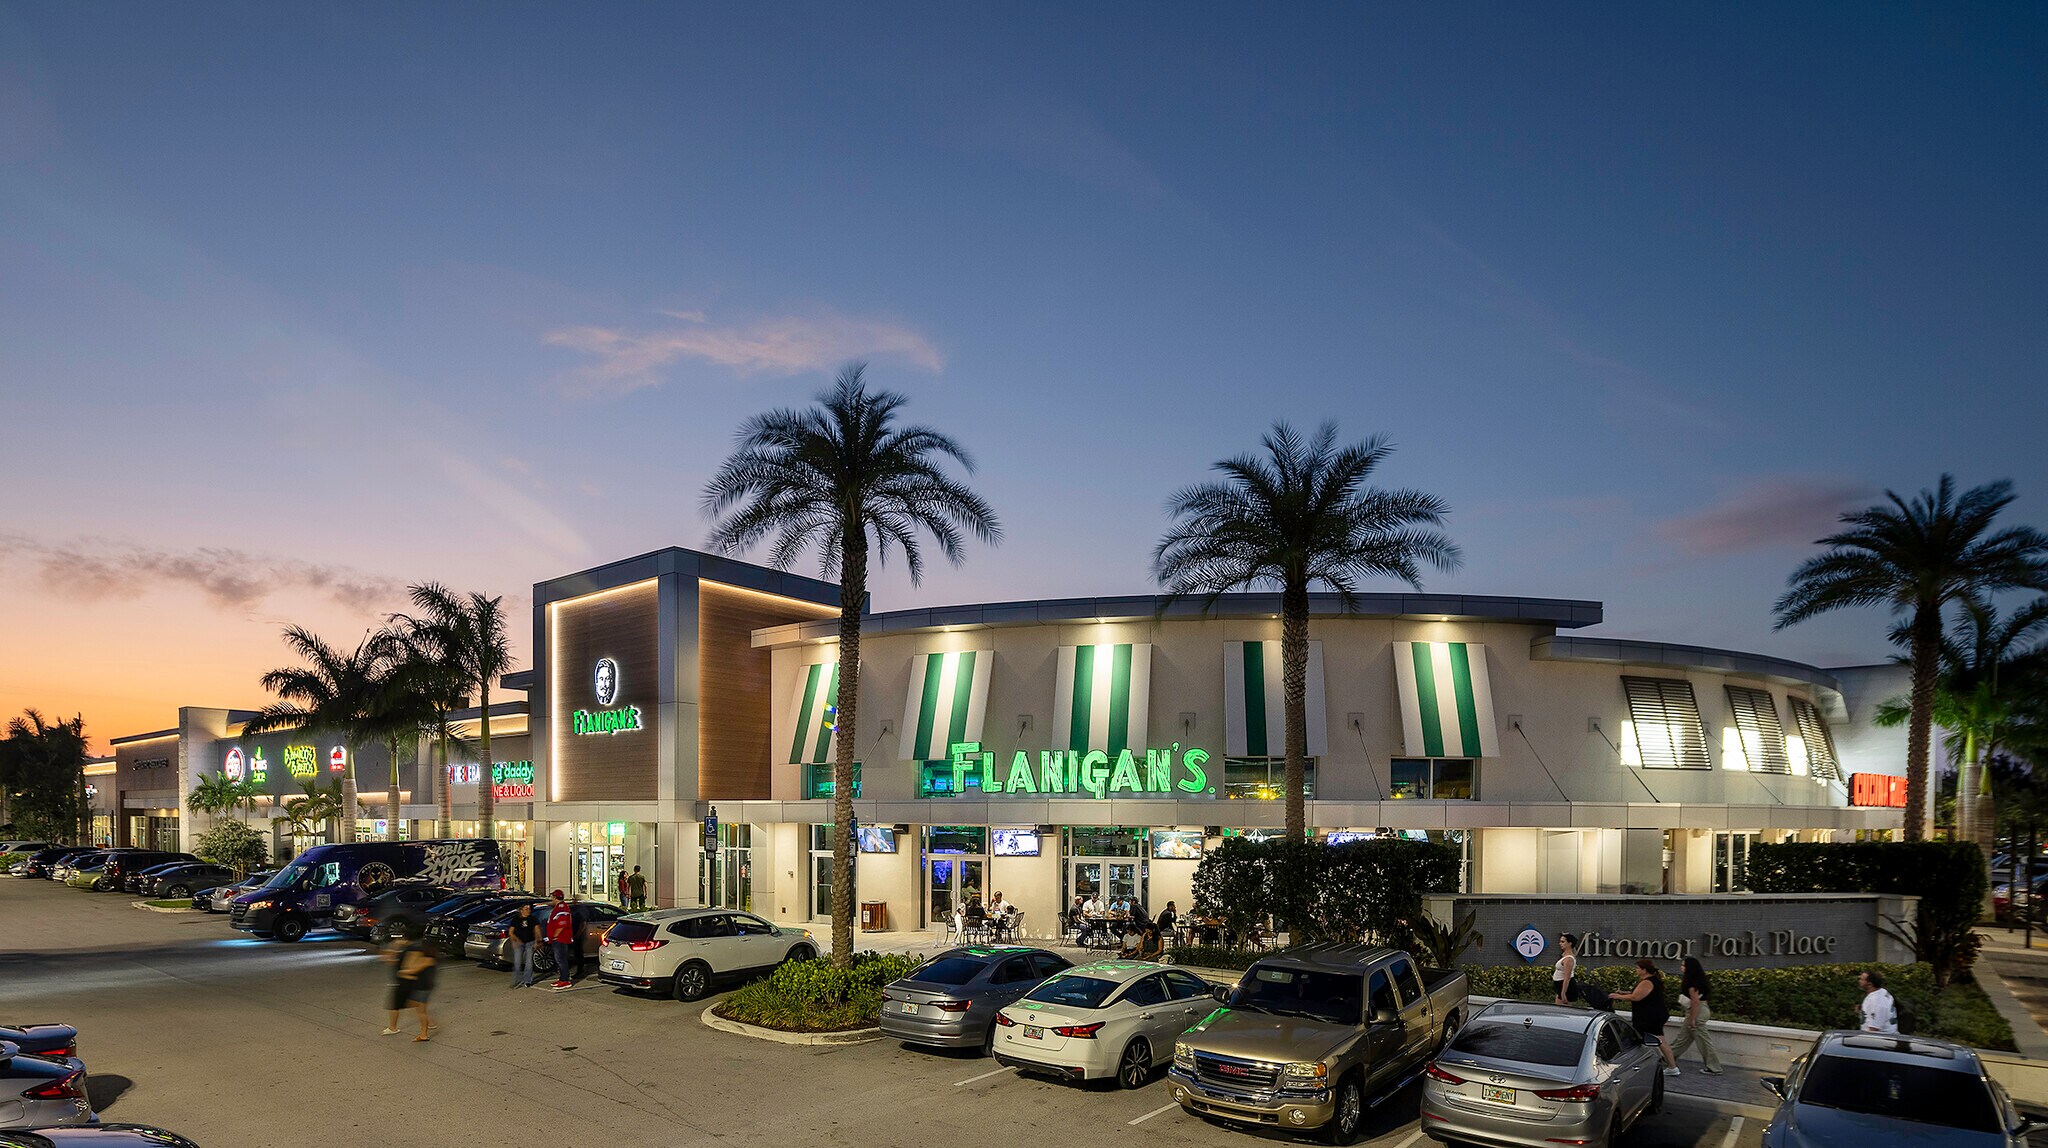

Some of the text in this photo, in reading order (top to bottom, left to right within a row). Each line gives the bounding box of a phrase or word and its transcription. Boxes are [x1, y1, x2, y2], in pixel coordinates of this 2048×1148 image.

[415, 851, 486, 877] SMOKE
[1769, 929, 1839, 955] Place
[1219, 1064, 1249, 1077] GMC
